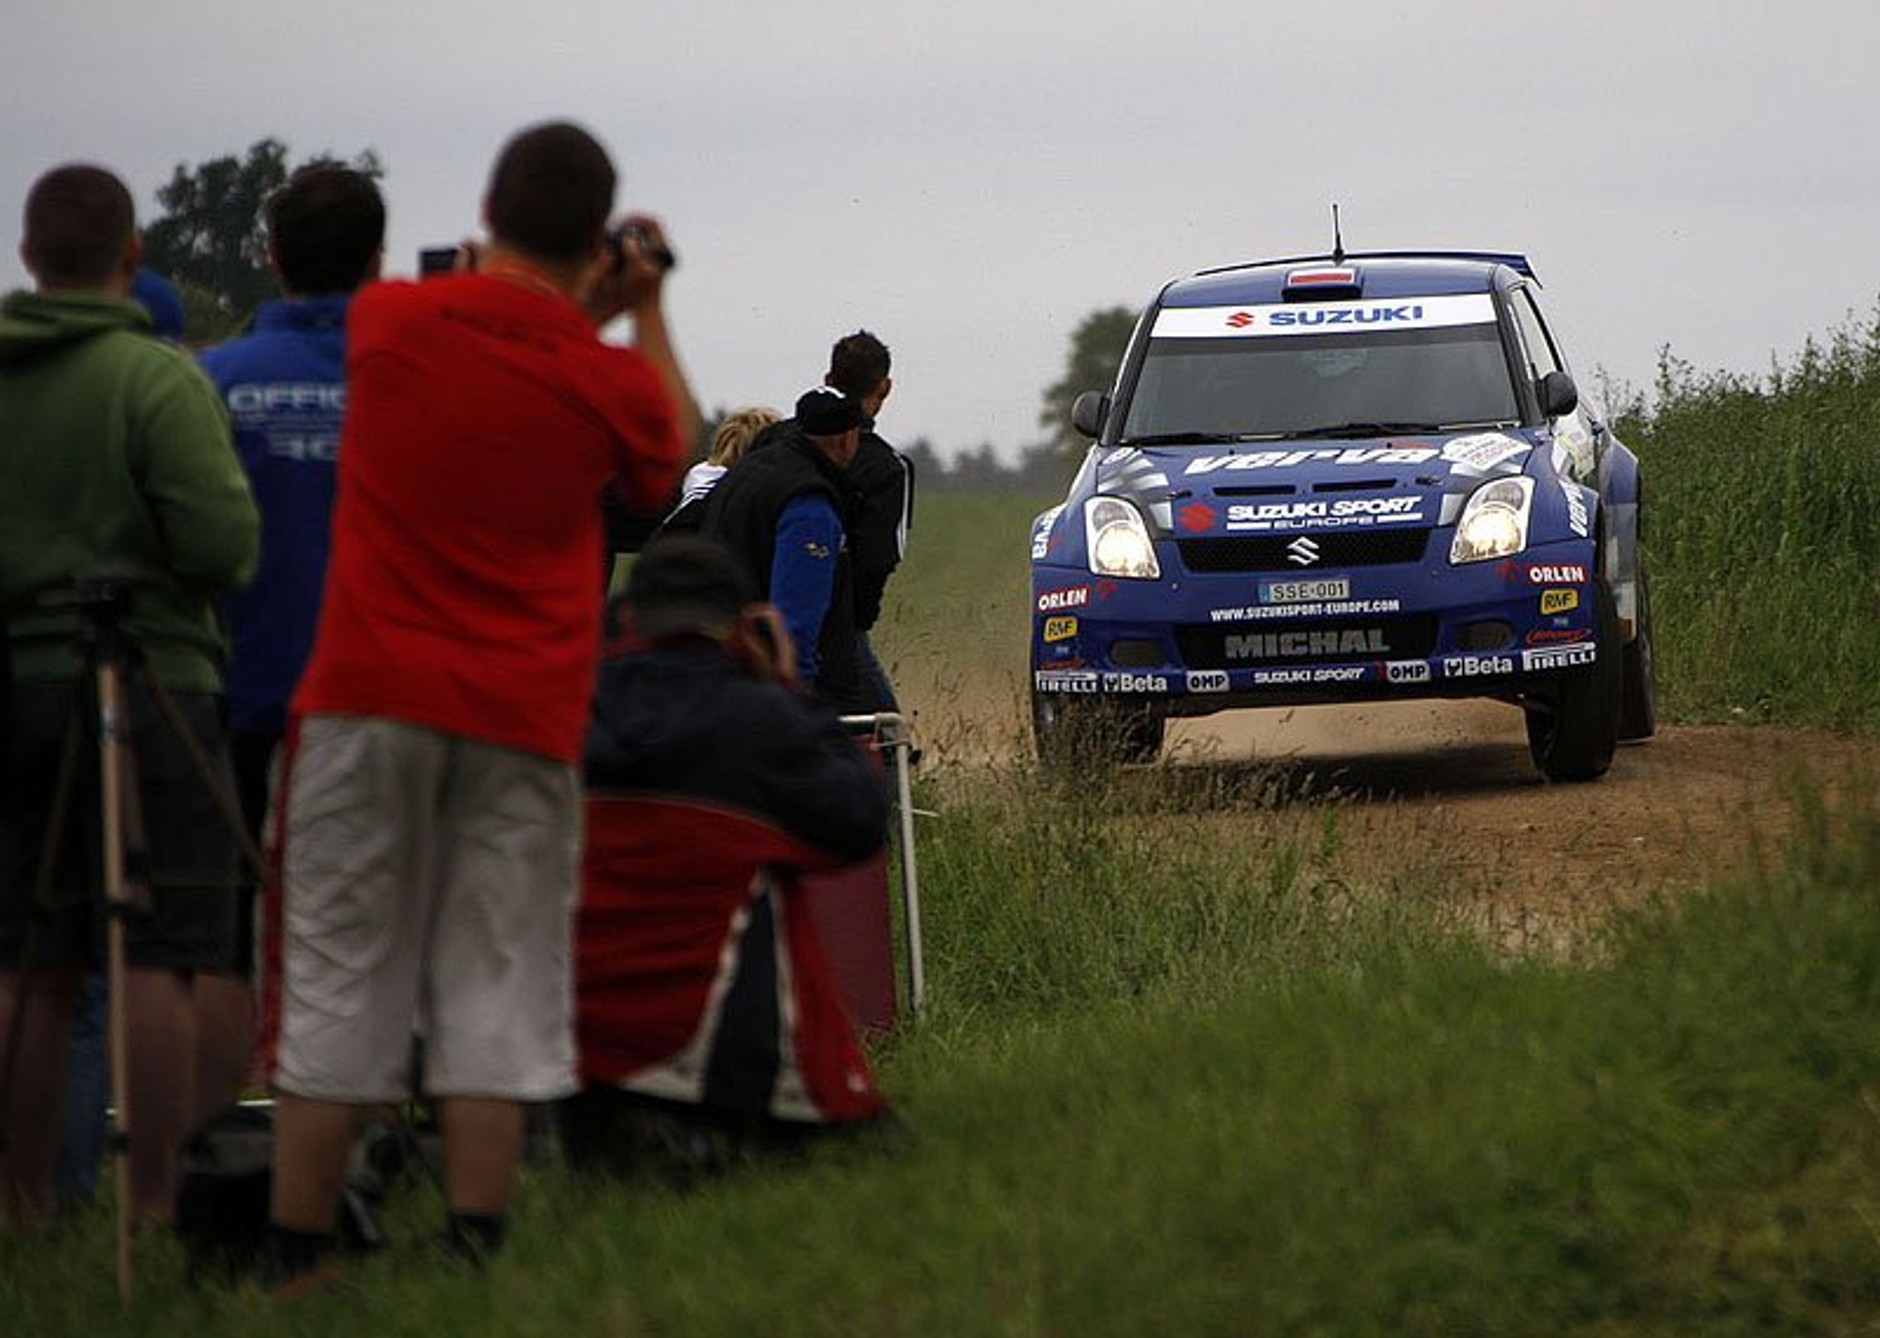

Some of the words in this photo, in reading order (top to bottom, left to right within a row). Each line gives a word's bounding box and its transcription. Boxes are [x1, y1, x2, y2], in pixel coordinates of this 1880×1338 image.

[1269, 305, 1423, 327] SUZUKI
[1226, 502, 1327, 520] SUZUKI
[1330, 496, 1422, 516] SPORT
[1273, 516, 1374, 529] EUROPE
[1529, 566, 1585, 583] ORLEN
[1038, 588, 1088, 610] ORLEN
[1225, 628, 1391, 660] MICHAL
[1463, 655, 1513, 676] Beta
[1521, 642, 1597, 672] PIRELLI
[1121, 672, 1168, 693] Beta
[1190, 674, 1226, 689] OMP
[1254, 672, 1310, 684] SUZUKI
[1314, 667, 1364, 681] SPORT
